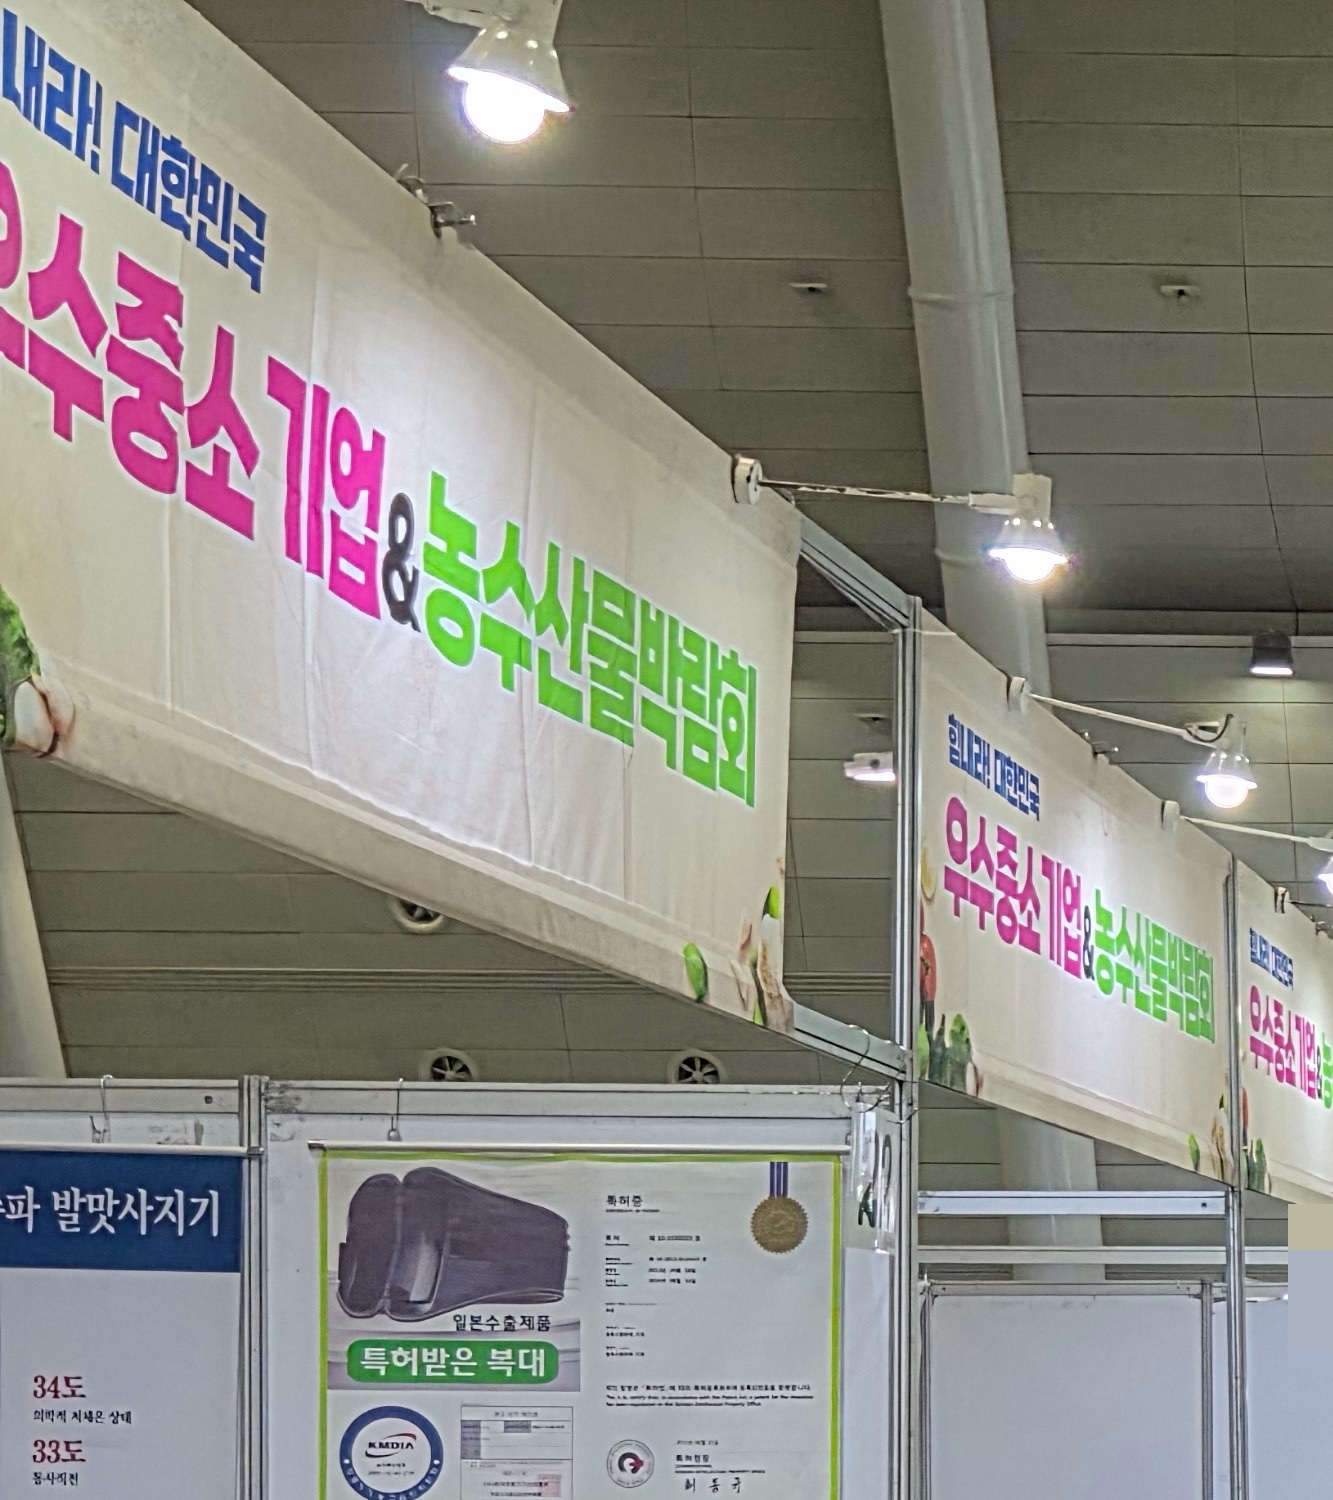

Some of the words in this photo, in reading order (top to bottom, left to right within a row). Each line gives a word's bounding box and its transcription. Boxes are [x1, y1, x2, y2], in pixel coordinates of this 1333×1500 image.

[2, 8, 103, 174] 내라!
[111, 101, 267, 294] 대한민국
[994, 748, 1040, 822] 대한민국
[944, 796, 1042, 956] 우수중소
[453, 1314, 551, 1332] 일본수출제품
[360, 1346, 478, 1377] 특허받은
[487, 1346, 545, 1378] 복대
[32, 1374, 86, 1400] 34도
[32, 1439, 86, 1463] 33도
